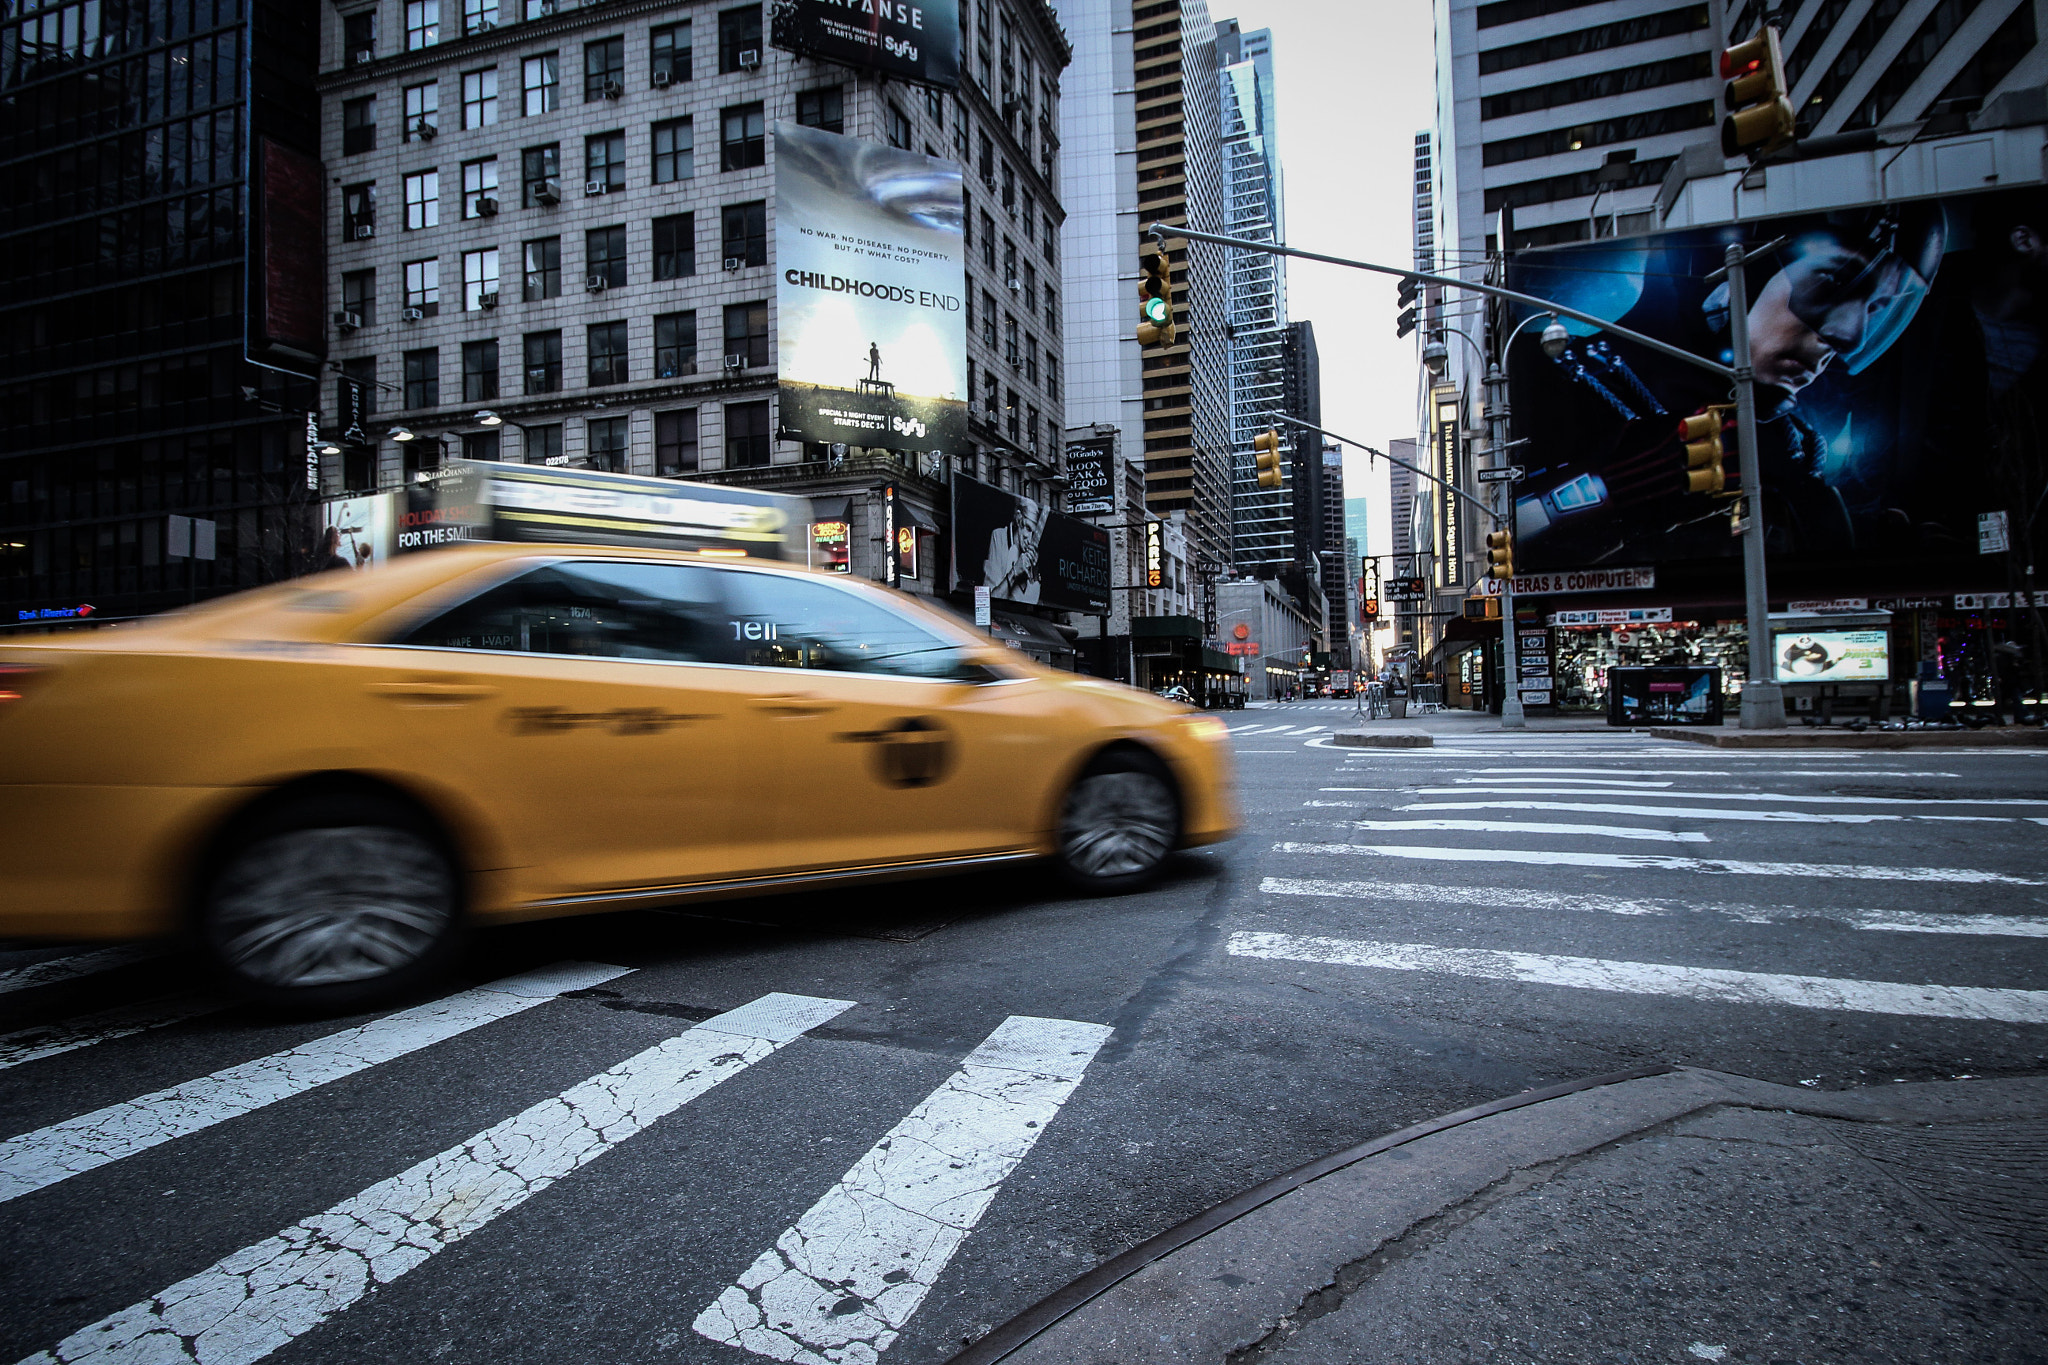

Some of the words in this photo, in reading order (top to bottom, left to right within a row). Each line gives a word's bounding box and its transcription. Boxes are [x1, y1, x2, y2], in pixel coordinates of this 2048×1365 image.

[815, 0, 922, 30] ANSE
[827, 27, 853, 40] STARTS
[855, 34, 868, 44] DEC
[885, 35, 918, 62] Syfy
[816, 231, 839, 240] WAR.
[842, 235, 854, 243] NO
[857, 239, 894, 251] DISEASE.
[912, 249, 950, 261] POVERTY.
[834, 244, 850, 252] BUT
[854, 247, 864, 255] AT
[867, 251, 891, 259] WHAT
[894, 255, 920, 264] COST?
[785, 269, 914, 304] CHILDHOOD'S
[920, 291, 960, 311] END
[818, 408, 842, 417] SPECIAL
[848, 411, 866, 419] NIGHT
[866, 413, 885, 421] EVENT
[833, 417, 860, 428] STARTS
[860, 420, 874, 429] DEC
[876, 422, 885, 430] 14
[893, 416, 925, 438] Syfy
[546, 455, 569, 466] 022178
[1070, 478, 1108, 489] FOOD
[1482, 471, 1496, 479] ONE
[1446, 491, 1454, 501] AT
[399, 508, 447, 528] HOLIDAY
[1446, 502, 1456, 525] TIMES
[399, 531, 421, 548] FOR
[423, 529, 444, 545] THE
[1148, 523, 1160, 570] PARK
[1446, 526, 1456, 556] SQUARE
[1082, 545, 1108, 568] KEITH
[1060, 558, 1108, 588] RICHARDS
[1364, 558, 1377, 600] PARK
[1448, 558, 1456, 584] HOTEL
[1554, 576, 1563, 591] &
[1567, 570, 1650, 590] COMPUTERS
[571, 606, 591, 619] 1674
[1791, 600, 1850, 609] COMPUTER
[1875, 597, 1943, 610] Galleries
[1461, 655, 1470, 682] PARK
[1859, 659, 1872, 668] 3
[1520, 677, 1551, 688] IBM
